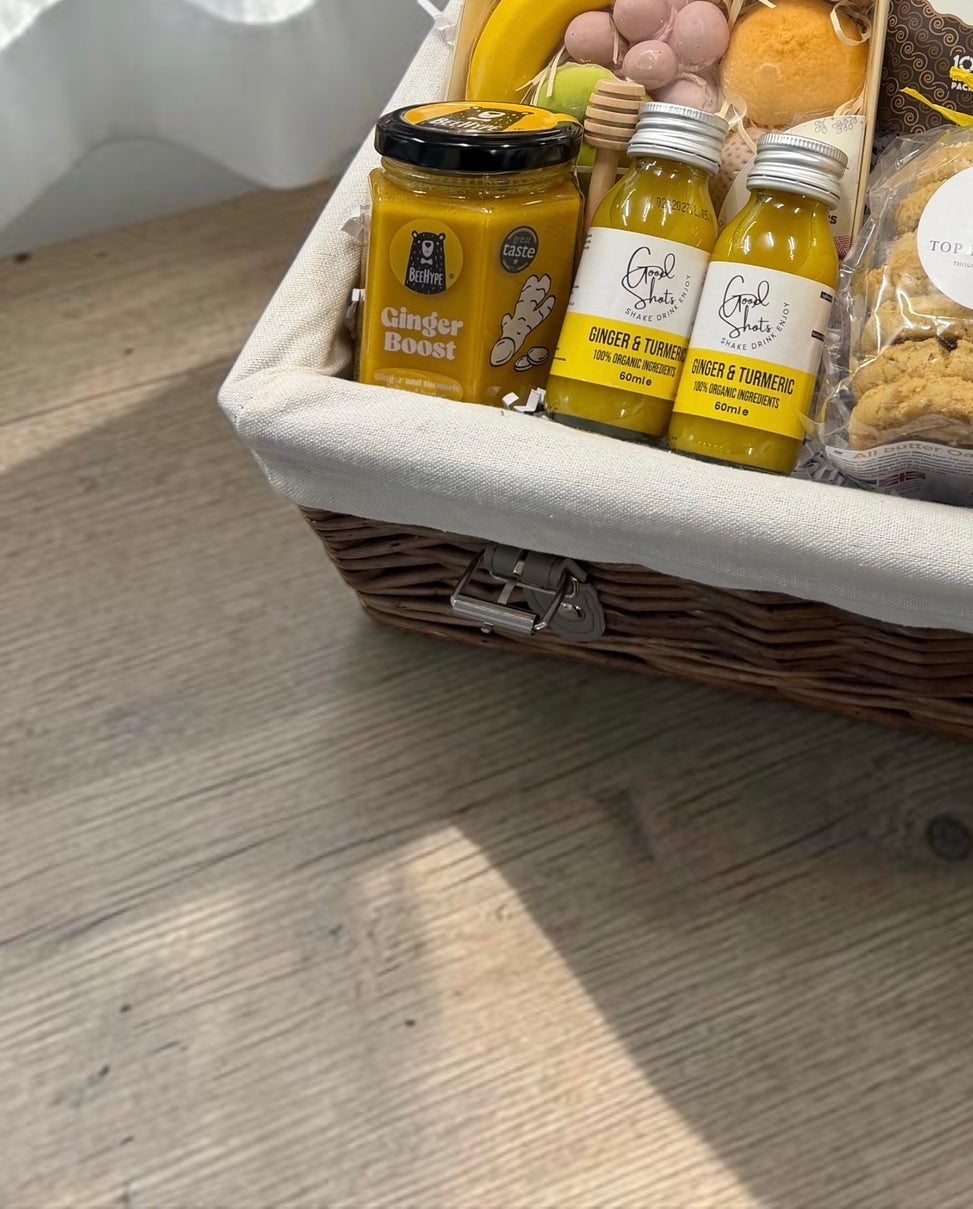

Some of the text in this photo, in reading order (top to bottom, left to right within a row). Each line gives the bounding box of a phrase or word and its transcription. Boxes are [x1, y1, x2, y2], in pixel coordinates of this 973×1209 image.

[503, 244, 535, 258] taste
[930, 240, 963, 253] TOP
[625, 246, 675, 288] Good
[622, 274, 676, 309] Shots
[624, 274, 691, 322] SHAKE DRINK ENJOY
[722, 275, 770, 318] Good
[380, 306, 463, 337] Ginger
[719, 302, 773, 338] Shots
[720, 302, 790, 351] SHAKE DRINK ENJOY
[384, 331, 456, 360] Boost
[589, 326, 629, 348] GINGER
[632, 336, 641, 351] &
[593, 349, 676, 378] 100% ORGANIC INGREDIENTS
[691, 358, 795, 395] GINGER & TURMERIC
[693, 380, 780, 409] 100% ORGANIC INGREDIENTS
[853, 450, 877, 460] All
[884, 443, 941, 453] butter
